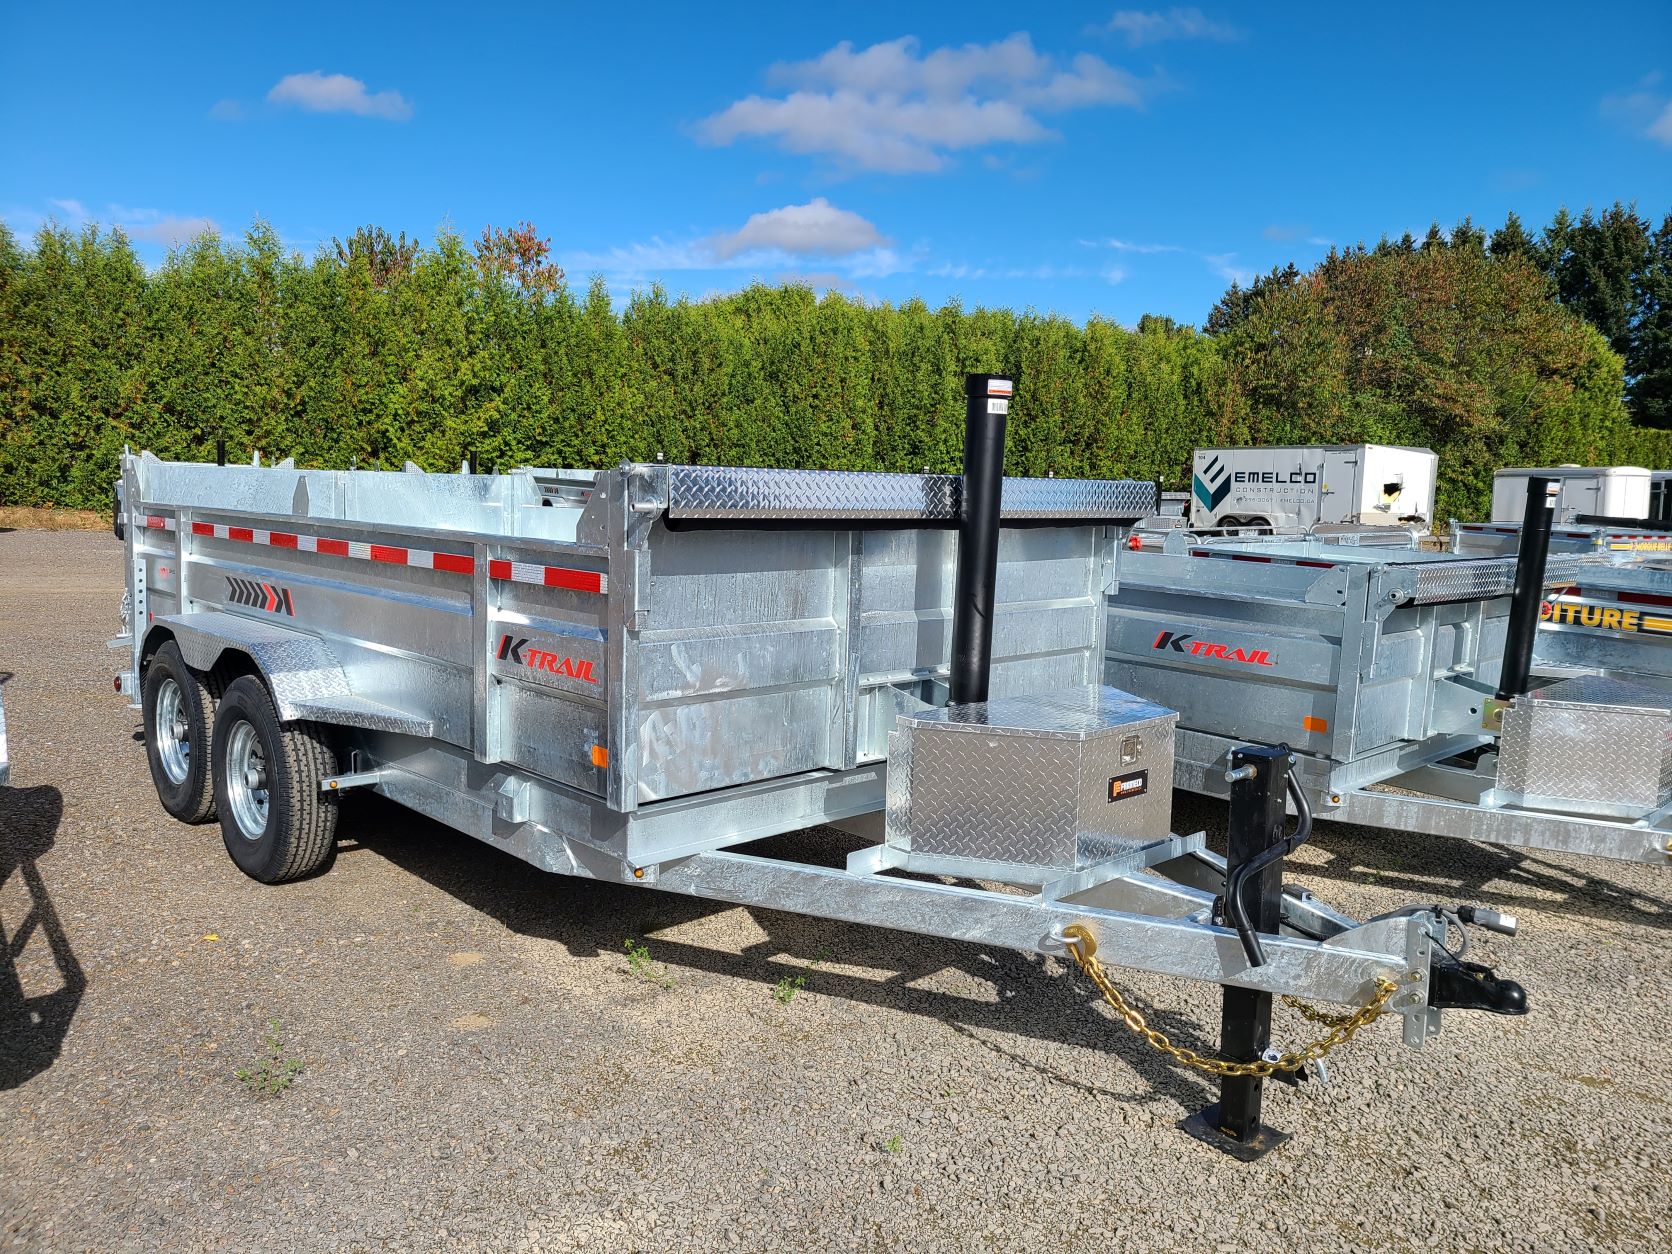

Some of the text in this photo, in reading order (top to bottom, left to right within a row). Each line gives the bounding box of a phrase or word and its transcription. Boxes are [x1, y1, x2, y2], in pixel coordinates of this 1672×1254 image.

[1234, 471, 1317, 484] EMELCO
[1235, 487, 1315, 495] CONSTRUCTION
[496, 632, 598, 683] K-TRAIL
[1153, 630, 1273, 667] K-TRAIL
